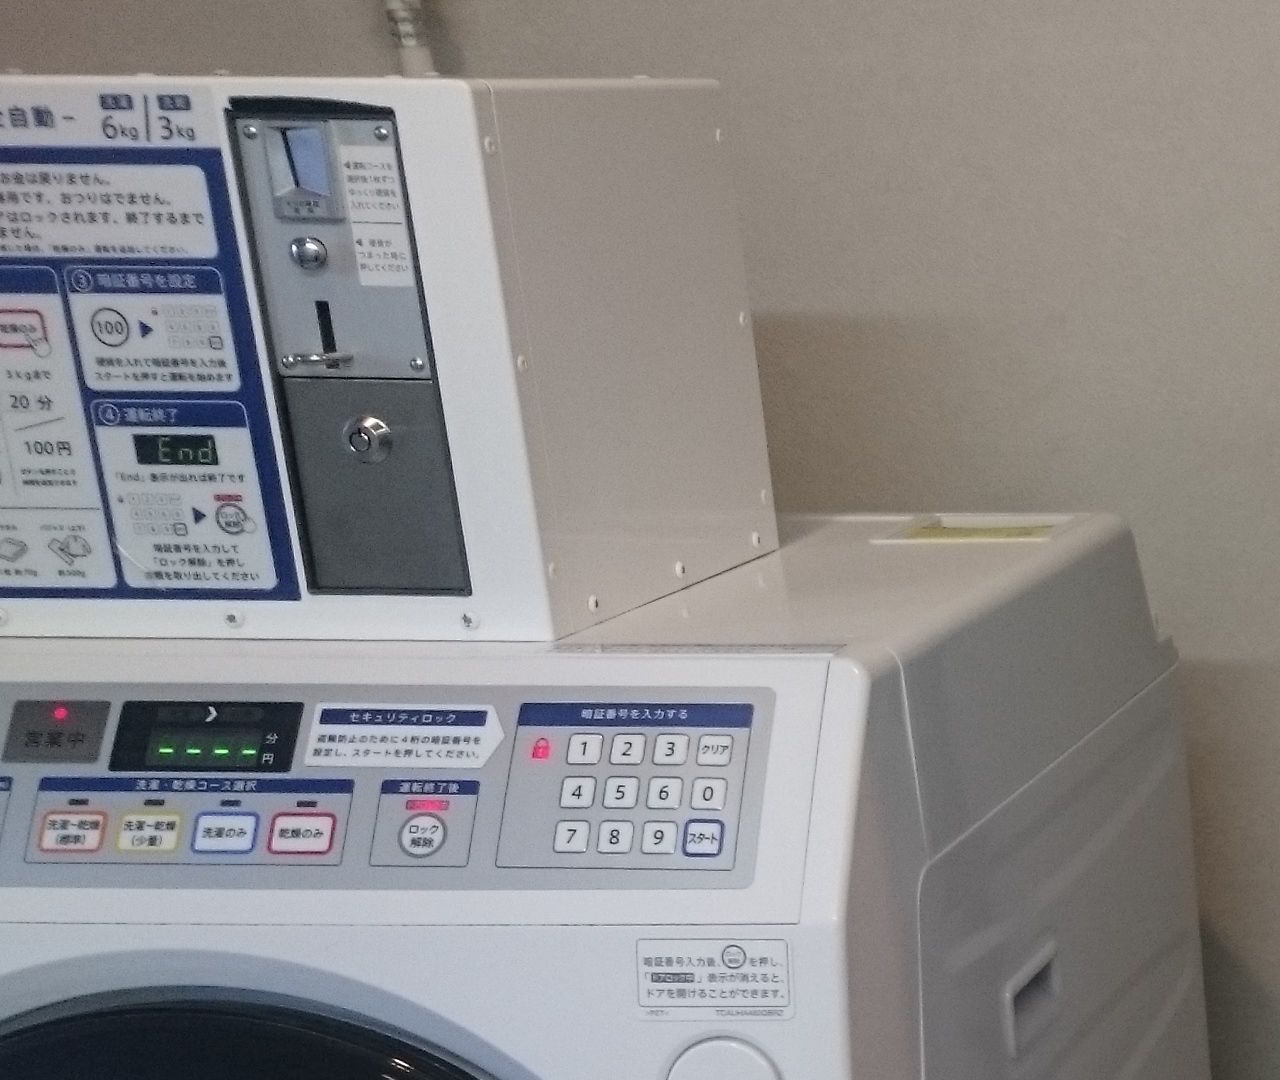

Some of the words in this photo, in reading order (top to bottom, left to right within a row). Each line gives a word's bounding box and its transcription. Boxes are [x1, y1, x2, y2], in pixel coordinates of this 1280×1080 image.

[0, 106, 54, 128] 自動
[102, 115, 139, 141] 6kg
[157, 116, 196, 141] 3kg
[25, 441, 72, 456] 100円
[349, 712, 457, 723] セキュリティロック
[581, 708, 688, 720] 暗証番号を入力する
[580, 742, 588, 756] 1
[621, 742, 632, 756] 2
[664, 742, 675, 757] 3
[702, 744, 729, 755] クリア
[571, 785, 583, 799] 4
[615, 785, 625, 800] 5
[658, 785, 669, 800] 6
[702, 786, 714, 801] 0
[202, 827, 247, 838] 洗濯のみ
[409, 825, 439, 835] ロック
[566, 829, 577, 844] 7
[609, 829, 620, 845] 8
[653, 830, 665, 845] 9
[688, 832, 718, 844] スタート
